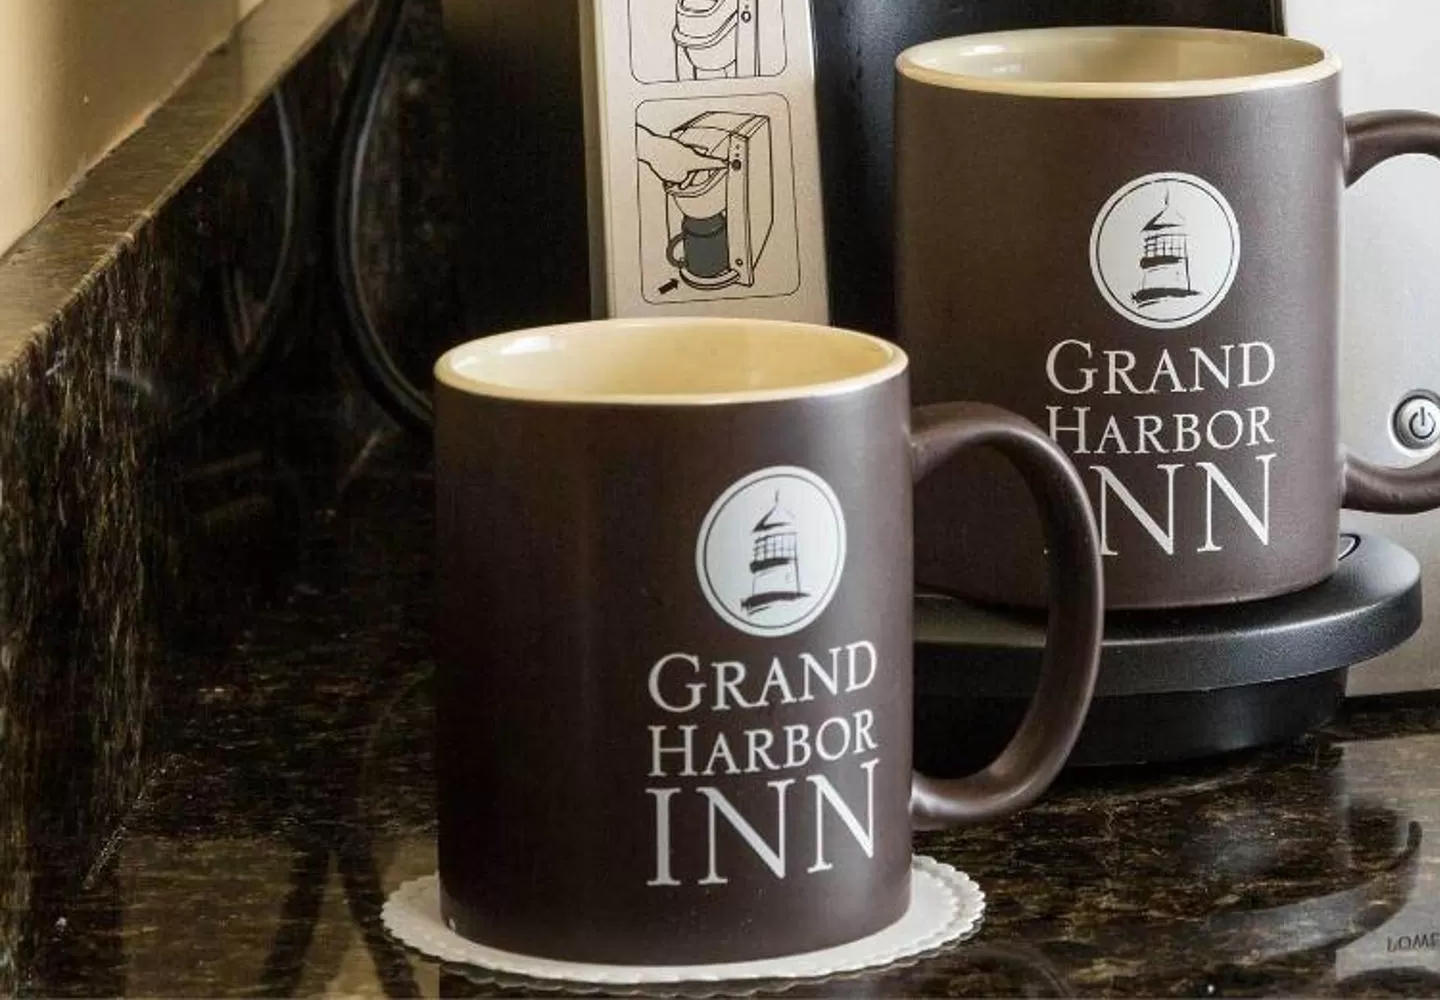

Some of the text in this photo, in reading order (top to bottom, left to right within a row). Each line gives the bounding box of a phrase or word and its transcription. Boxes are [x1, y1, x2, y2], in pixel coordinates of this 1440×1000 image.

[1045, 339, 1276, 395] GRAND
[1045, 405, 1275, 454] HARBOR
[1089, 453, 1278, 556] NN
[648, 640, 878, 713] GRAND
[647, 709, 879, 777] HARBOR
[645, 757, 881, 887] INN
